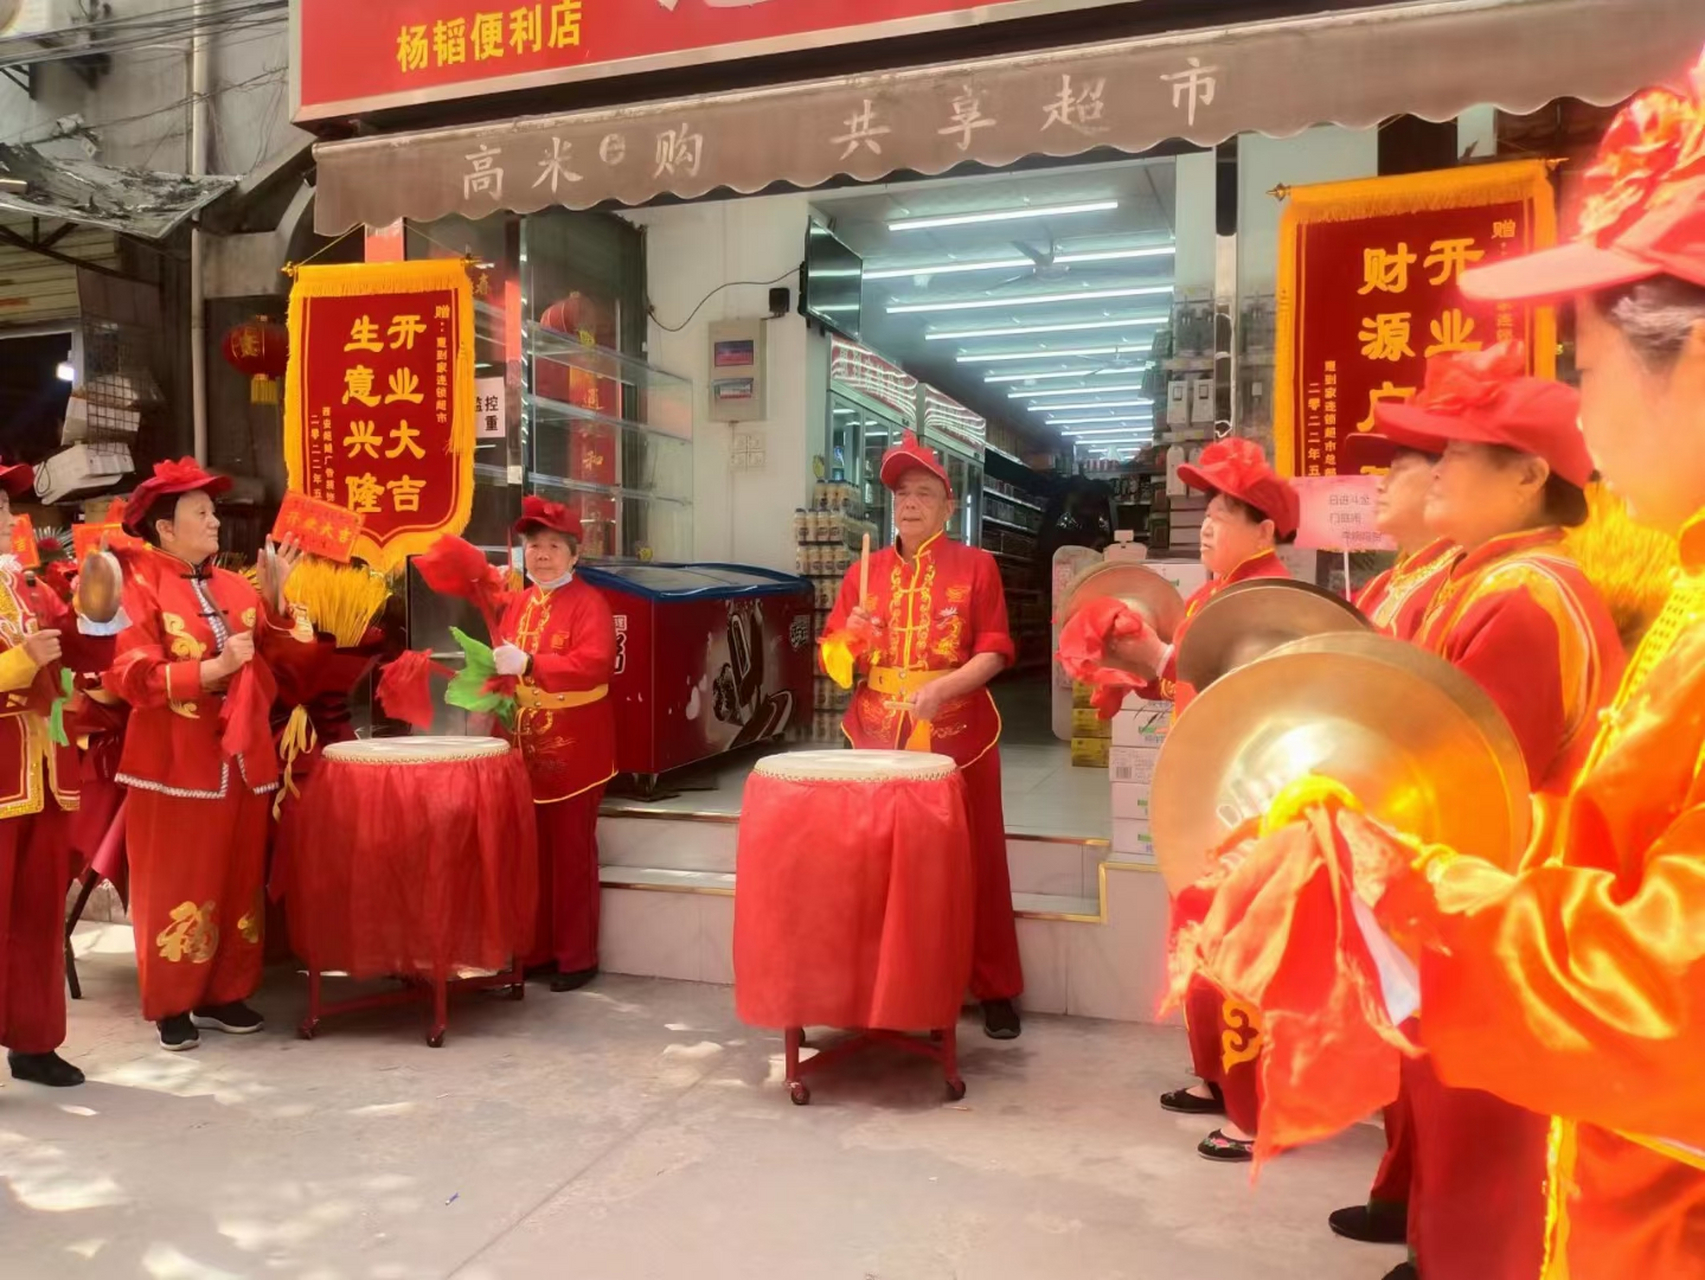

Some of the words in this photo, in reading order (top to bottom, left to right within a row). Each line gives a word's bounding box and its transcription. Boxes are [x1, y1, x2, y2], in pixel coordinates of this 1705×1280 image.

[396, 0, 582, 73] 杨韬便利店
[830, 56, 1220, 161] 共享超市
[342, 314, 385, 514] 生意兴隆
[385, 314, 427, 512] 开业大吉
[1356, 242, 1417, 477] 财源广
